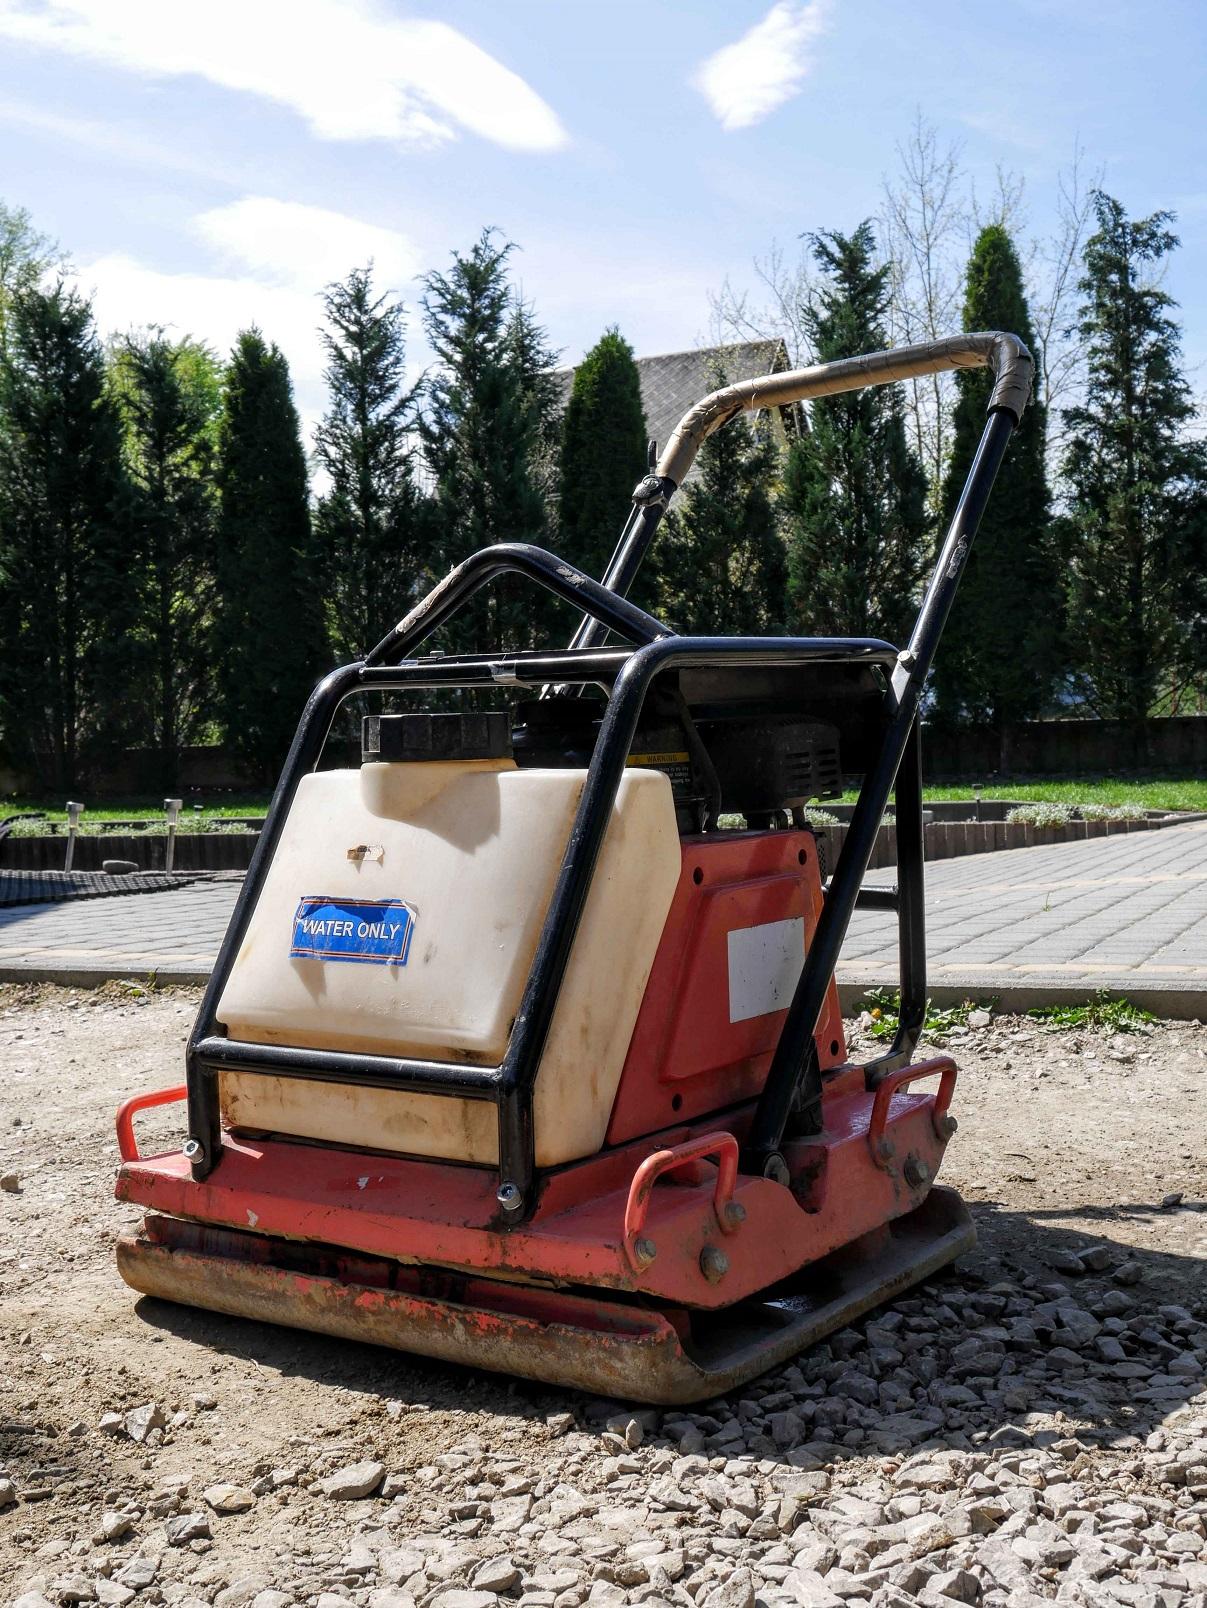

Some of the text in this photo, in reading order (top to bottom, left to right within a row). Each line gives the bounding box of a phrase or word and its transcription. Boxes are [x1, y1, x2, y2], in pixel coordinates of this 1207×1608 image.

[647, 754, 678, 763] WARNING
[302, 920, 401, 940] WATER ONLY
